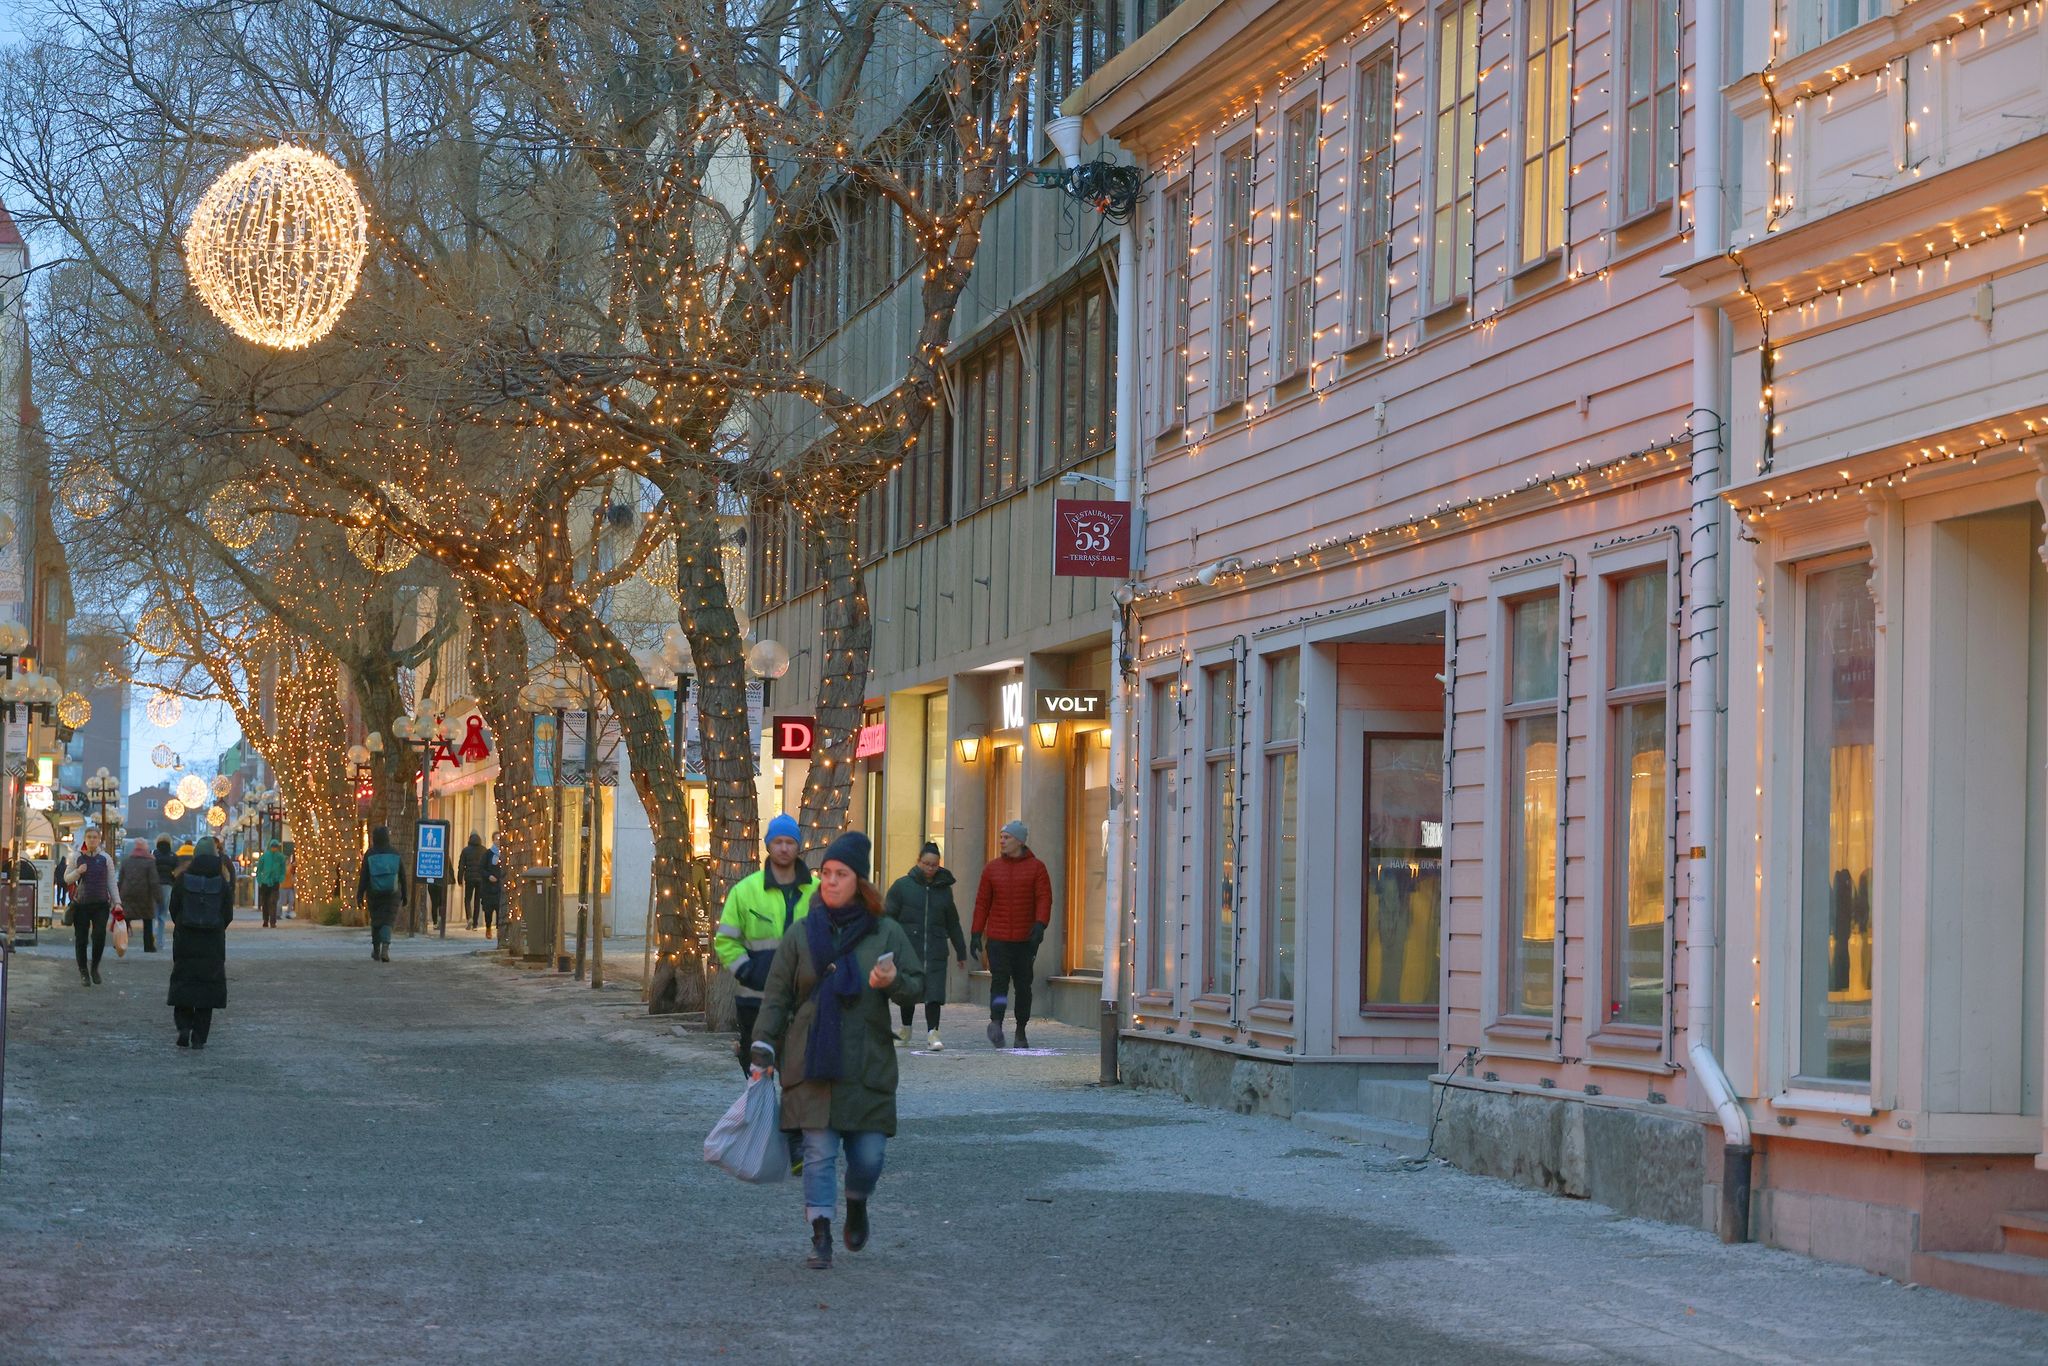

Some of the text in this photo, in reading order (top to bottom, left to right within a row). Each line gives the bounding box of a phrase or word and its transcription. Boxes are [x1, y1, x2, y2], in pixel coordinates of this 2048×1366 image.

[1071, 509, 1116, 525] RESTAURANG
[1075, 522, 1110, 552] 53
[1002, 681, 1024, 730] VOL
[1044, 696, 1098, 712] VOLT
